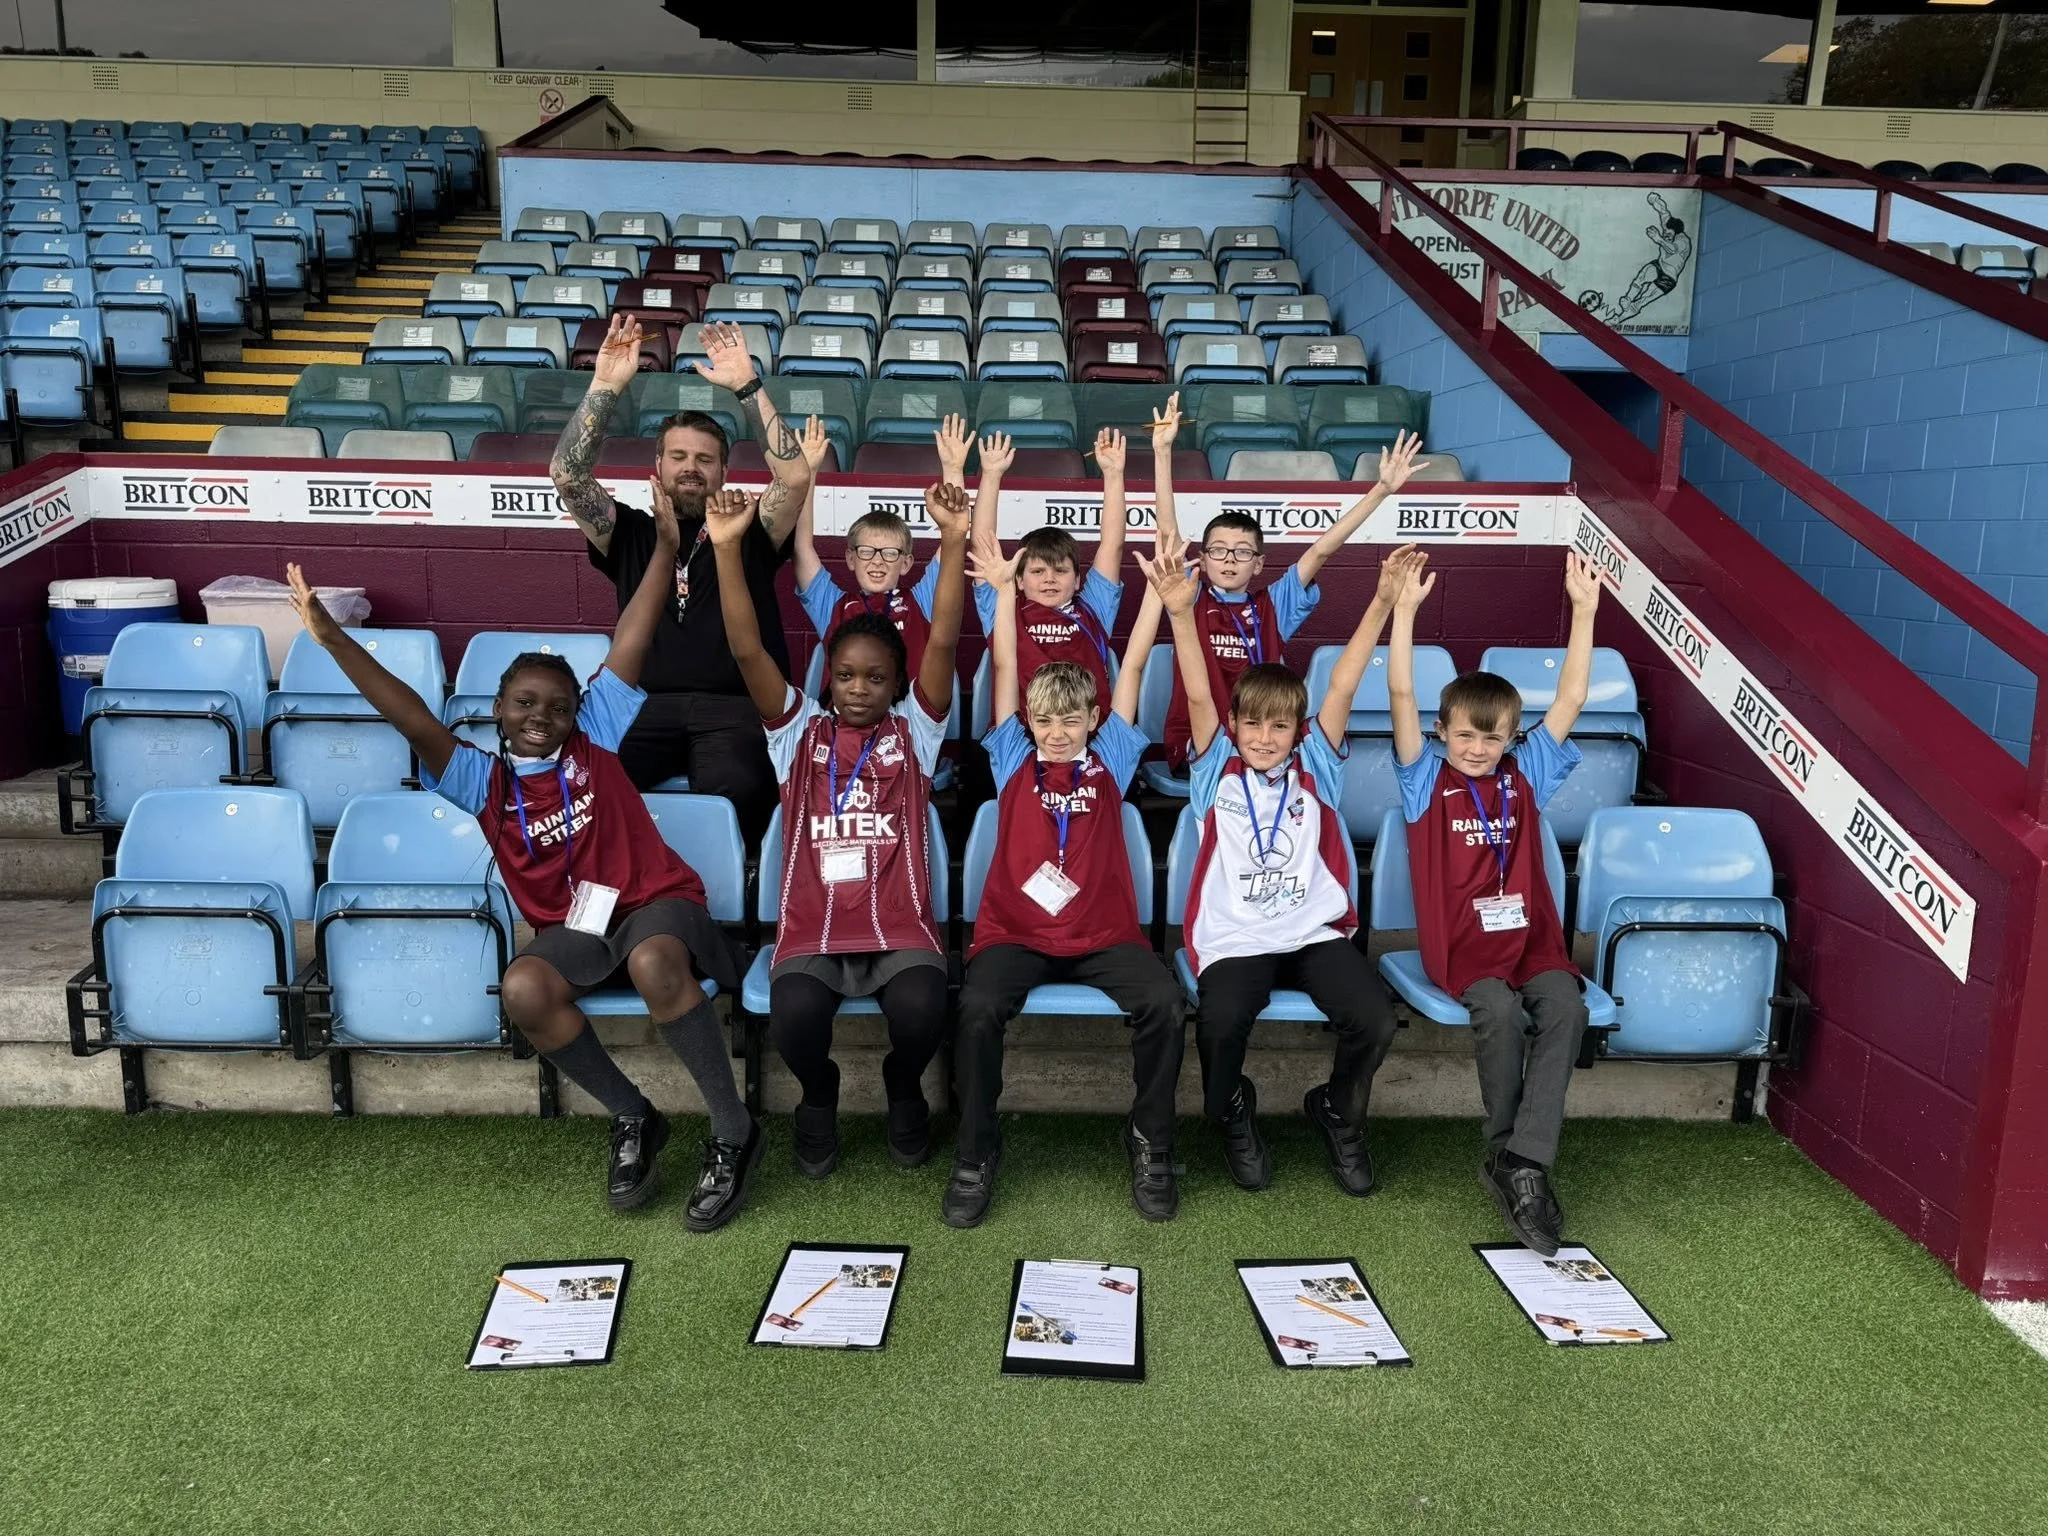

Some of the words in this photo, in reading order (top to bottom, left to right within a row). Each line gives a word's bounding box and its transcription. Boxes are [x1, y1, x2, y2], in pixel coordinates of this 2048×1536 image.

[493, 74, 513, 84] KEEP
[516, 75, 552, 85] GANGWAY
[554, 76, 579, 86] CLEAR
[1502, 198, 1580, 261] UNITED
[1498, 267, 1566, 318] PAK
[124, 483, 249, 506] BRITCON
[307, 487, 433, 510] BRITCON
[1045, 506, 1158, 527] BRITON
[1397, 509, 1519, 530] BRITCON
[1576, 518, 1627, 584] BRITCON
[1025, 623, 1080, 636] AINHAM
[1645, 591, 1709, 671] BRITCON
[1212, 646, 1249, 659] TEEL
[1732, 684, 1815, 783] BRITCON
[811, 813, 897, 841] HITEK
[1847, 807, 1958, 935] BRITCON
